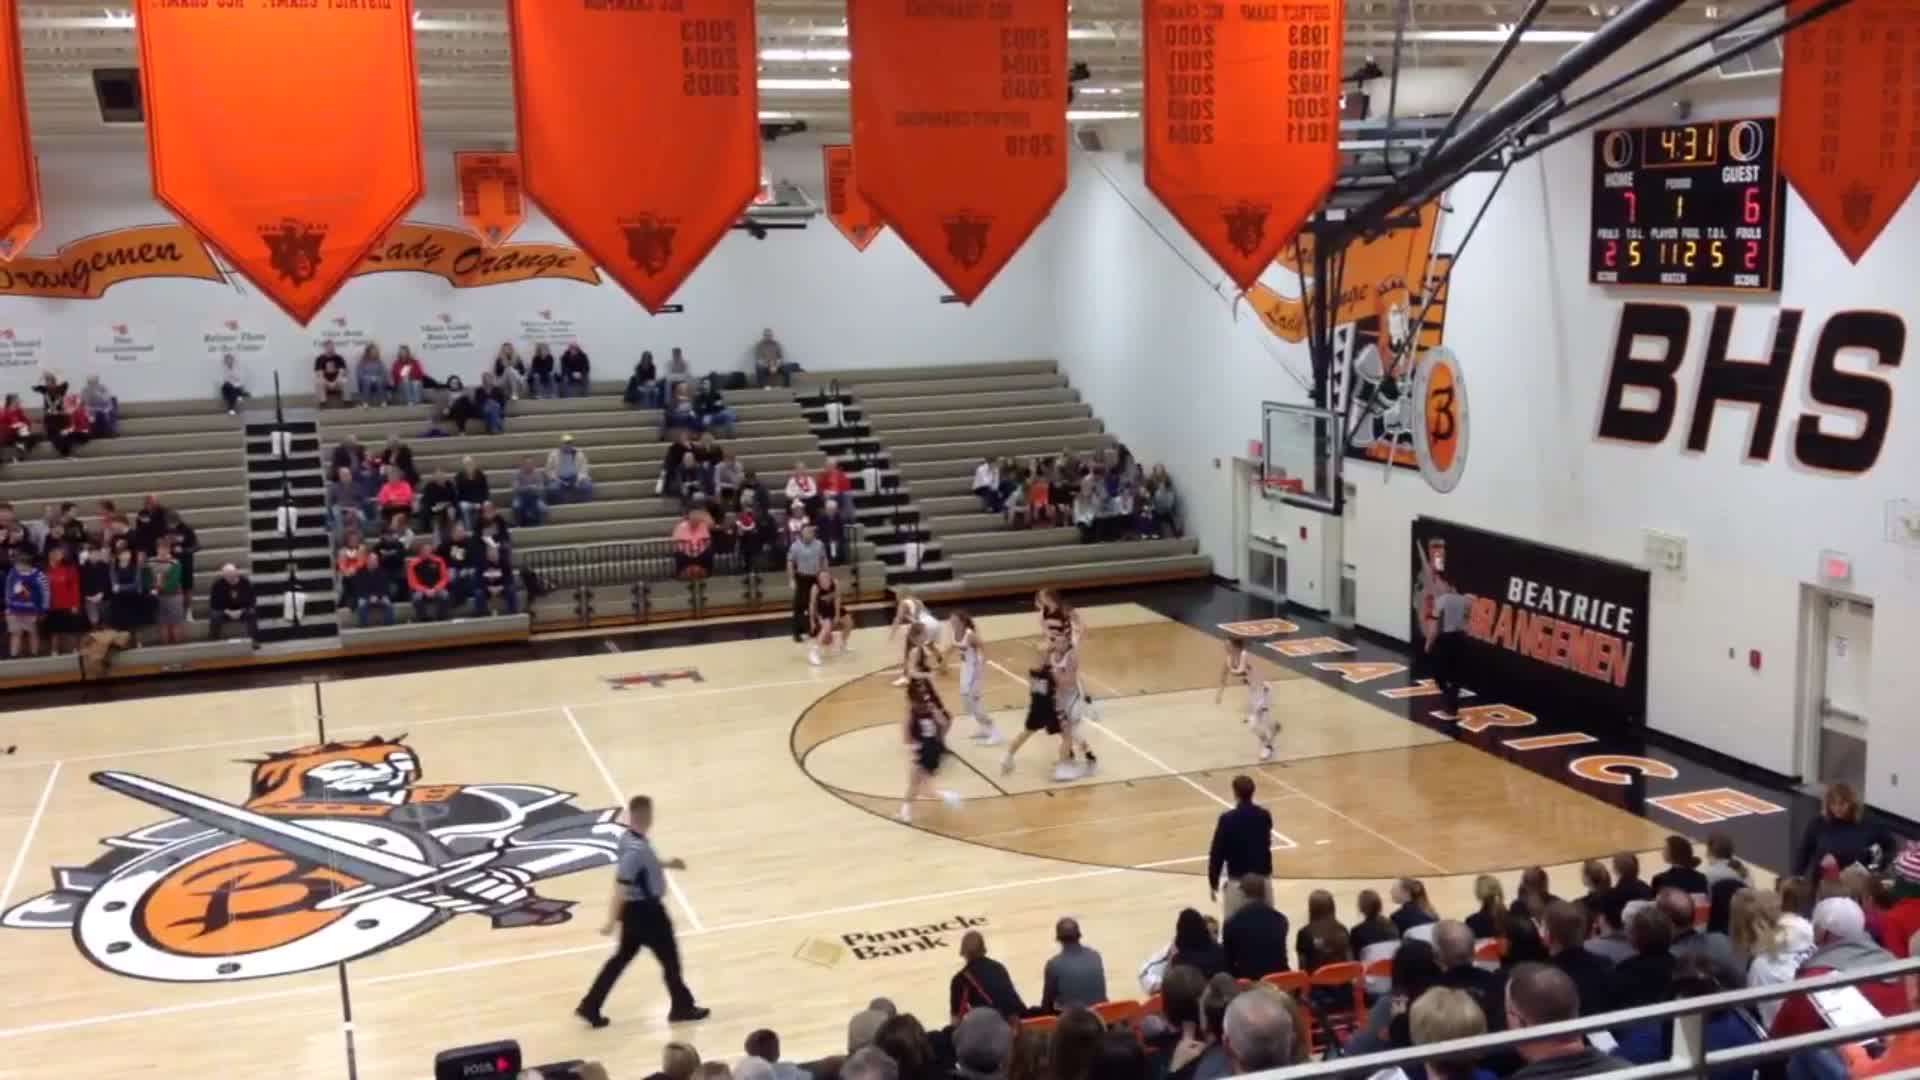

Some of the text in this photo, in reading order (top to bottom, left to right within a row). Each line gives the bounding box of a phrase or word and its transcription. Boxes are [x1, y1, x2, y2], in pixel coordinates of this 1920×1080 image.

[1661, 126, 1714, 162] 4:31
[1604, 171, 1634, 188] HOME
[1721, 165, 1761, 184] GUEST
[1623, 191, 1637, 223] 7
[1675, 194, 1684, 219] 1
[1743, 187, 1761, 224] 6
[1735, 227, 1763, 240] FOULS
[453, 245, 577, 276] Orange
[1604, 240, 1618, 267] 2
[1628, 240, 1641, 267] 5
[1710, 240, 1724, 269] 5
[1743, 240, 1759, 270] 2
[1595, 301, 1908, 476] BHS
[1507, 575, 1635, 635] BEATRICE
[1218, 618, 1787, 825] BEATRICE
[842, 915, 989, 946] Pinnacle
[852, 935, 950, 960] Bank
